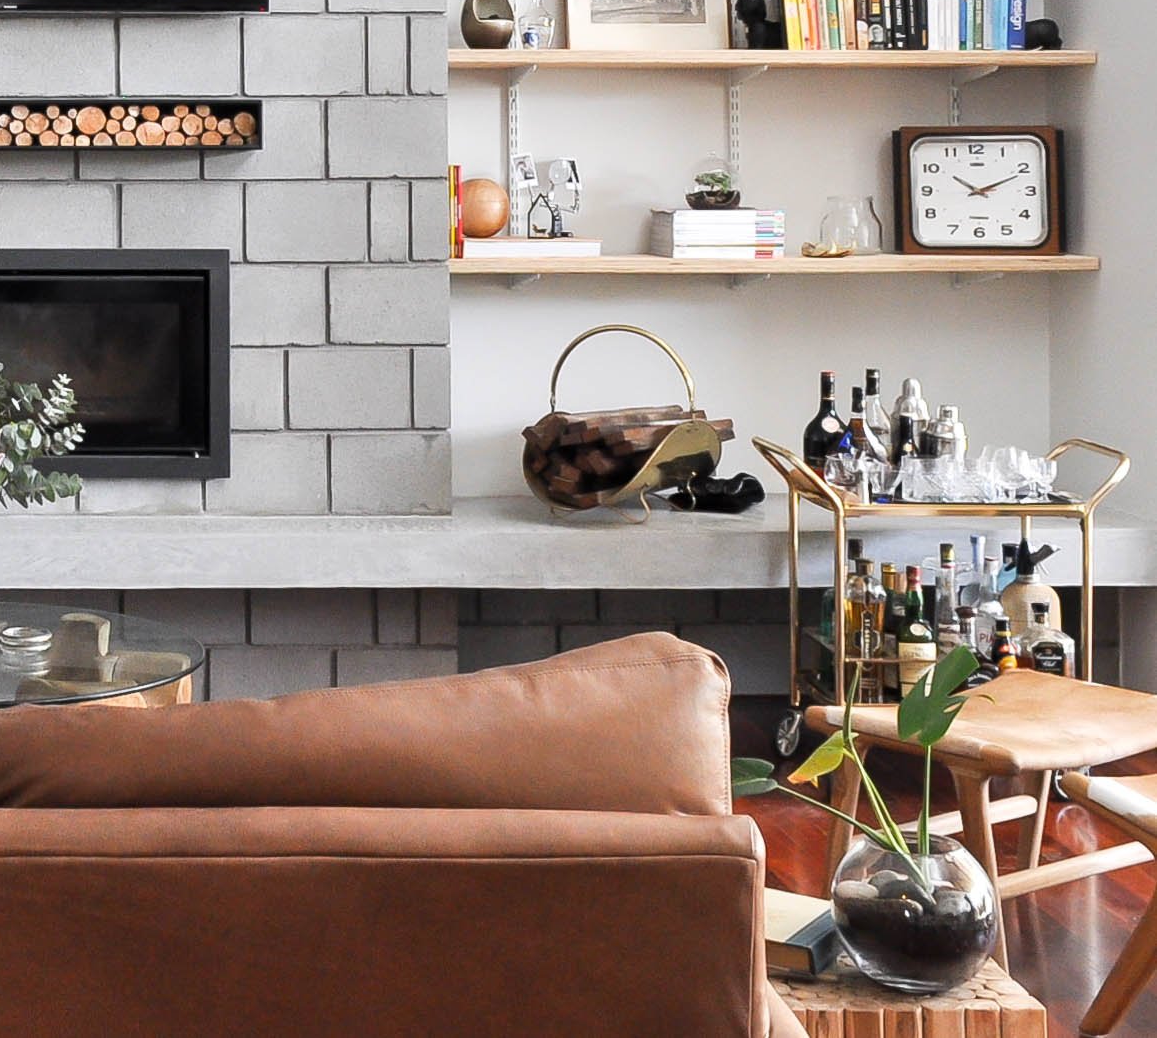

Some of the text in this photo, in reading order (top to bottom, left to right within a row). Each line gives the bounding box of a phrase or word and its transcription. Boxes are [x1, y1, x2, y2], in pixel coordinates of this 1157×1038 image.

[944, 147, 957, 158] 11
[968, 144, 985, 155] 12
[1000, 146, 1005, 157] 1
[923, 163, 940, 174] 10
[1017, 162, 1030, 174] 2
[921, 185, 933, 197] 9
[1025, 185, 1037, 197] 3
[925, 207, 937, 219] 8
[1018, 209, 1031, 220] 4
[947, 224, 959, 235] 7
[973, 227, 986, 238] 6
[1001, 224, 1013, 235] 5
